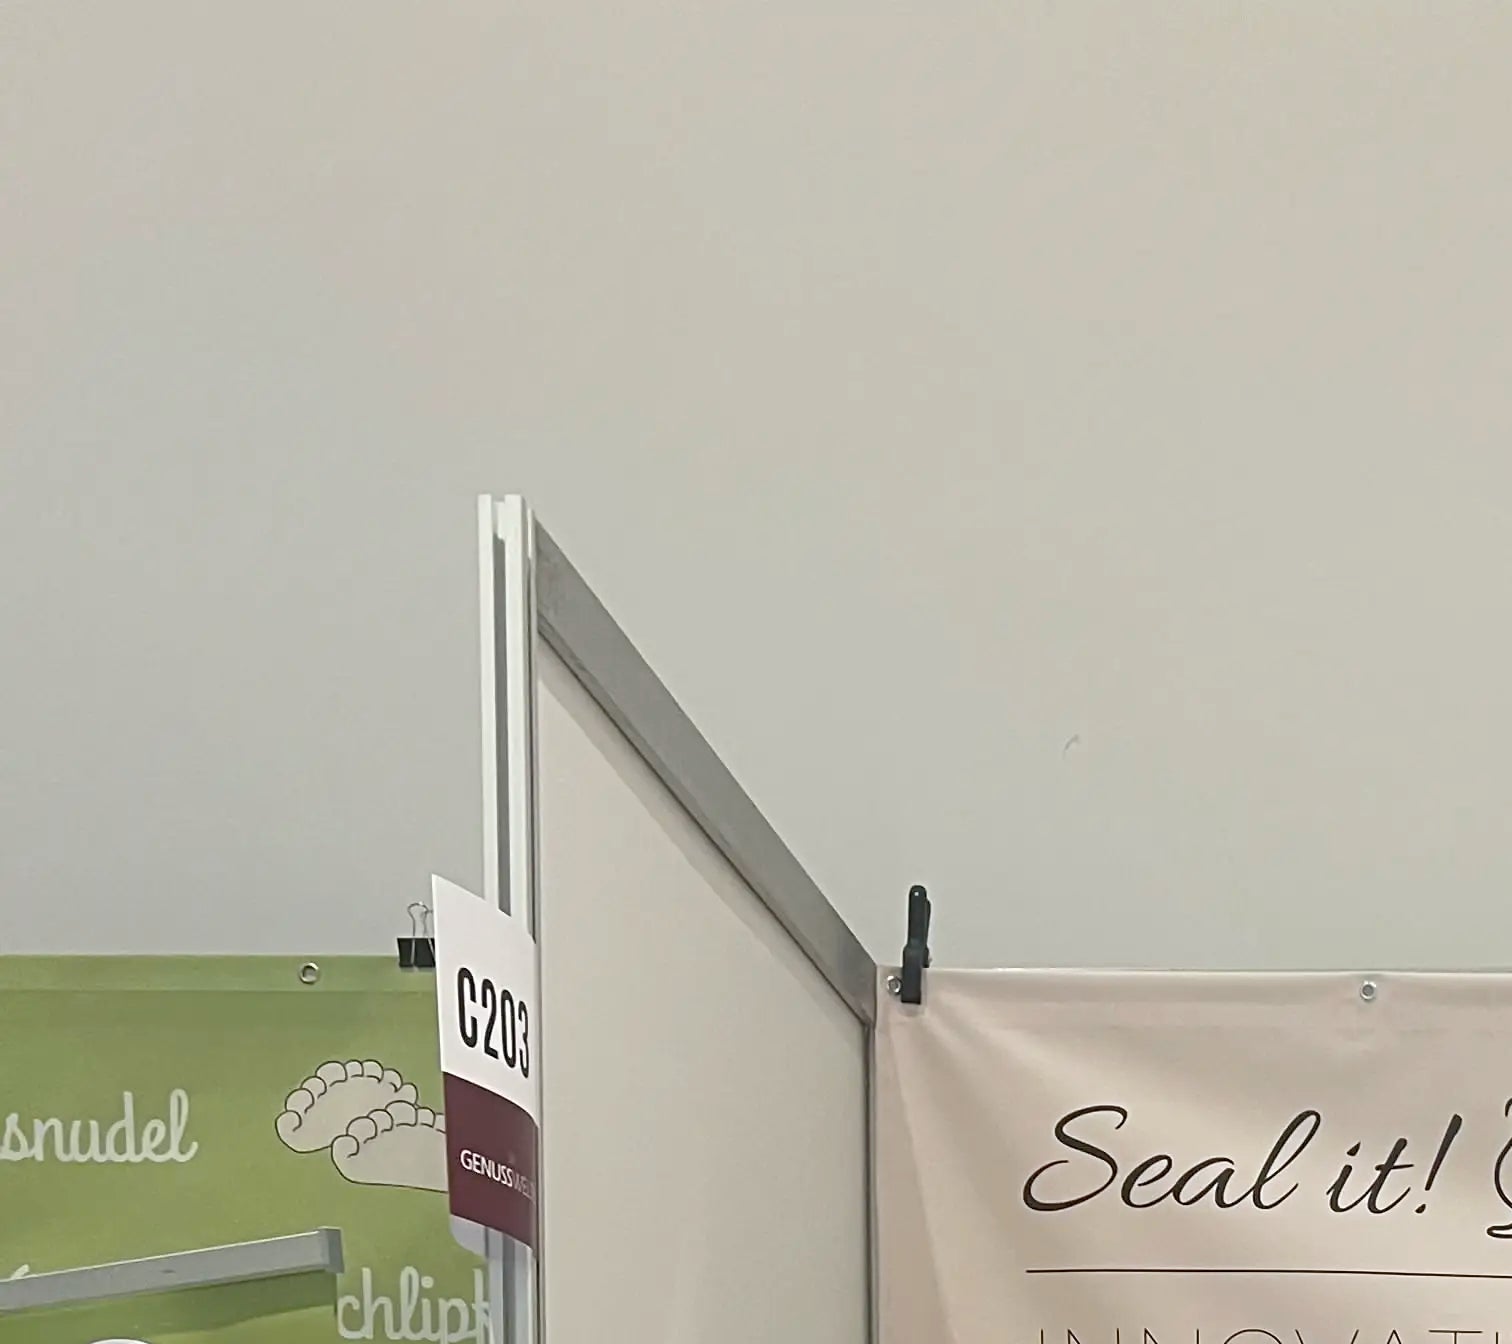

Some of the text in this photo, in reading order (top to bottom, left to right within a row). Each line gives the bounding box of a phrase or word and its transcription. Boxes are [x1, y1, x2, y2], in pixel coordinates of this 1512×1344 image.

[457, 966, 530, 1079] C203
[1022, 1104, 1463, 1215] Seal it!
